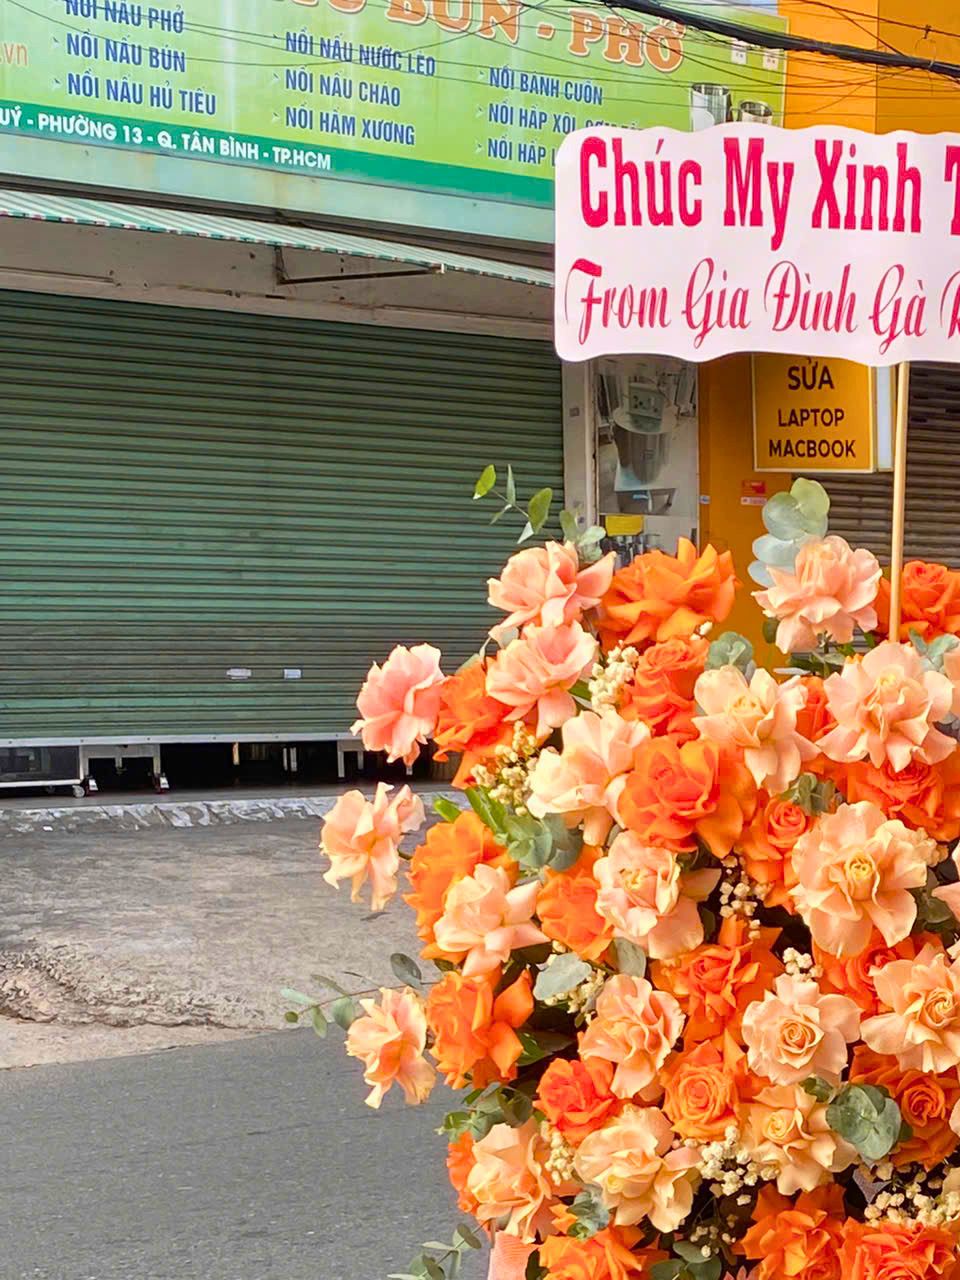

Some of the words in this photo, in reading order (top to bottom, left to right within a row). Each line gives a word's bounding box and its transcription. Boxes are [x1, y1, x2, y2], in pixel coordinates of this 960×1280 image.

[148, 5, 185, 33] PHỞ
[66, 28, 98, 59] NỒI
[105, 35, 142, 65] NẤU
[149, 45, 185, 72] BÚN
[285, 27, 314, 55] NỒI
[319, 33, 353, 62] NẤU
[67, 69, 99, 99] NỒI
[106, 75, 143, 105] NẤU
[150, 80, 173, 110] HỦ
[285, 64, 314, 93] NỒI
[319, 71, 353, 99] NẤU
[358, 80, 401, 107] CHÁO
[489, 63, 515, 90] NỒI
[285, 102, 314, 130] NỒI
[361, 119, 415, 146] XƯƠNG
[488, 99, 514, 126] NỒI
[38, 112, 117, 140] PHƯỜNG
[122, 125, 143, 145] 13
[157, 131, 177, 150] Q.
[181, 130, 215, 153] TÂN
[219, 136, 259, 161] BÌNH
[272, 147, 332, 170] TP.HCM
[487, 134, 513, 161] NỒI
[580, 136, 702, 228] Chúc
[723, 137, 795, 251] My
[811, 139, 922, 233] Xinh
[564, 258, 672, 345] From
[681, 257, 752, 349] Gia
[764, 260, 858, 334] Đình
[868, 264, 927, 355] Gà
[788, 358, 834, 390] SỬA
[778, 408, 845, 427] LAPTOP
[769, 439, 856, 458] MACBOOK
